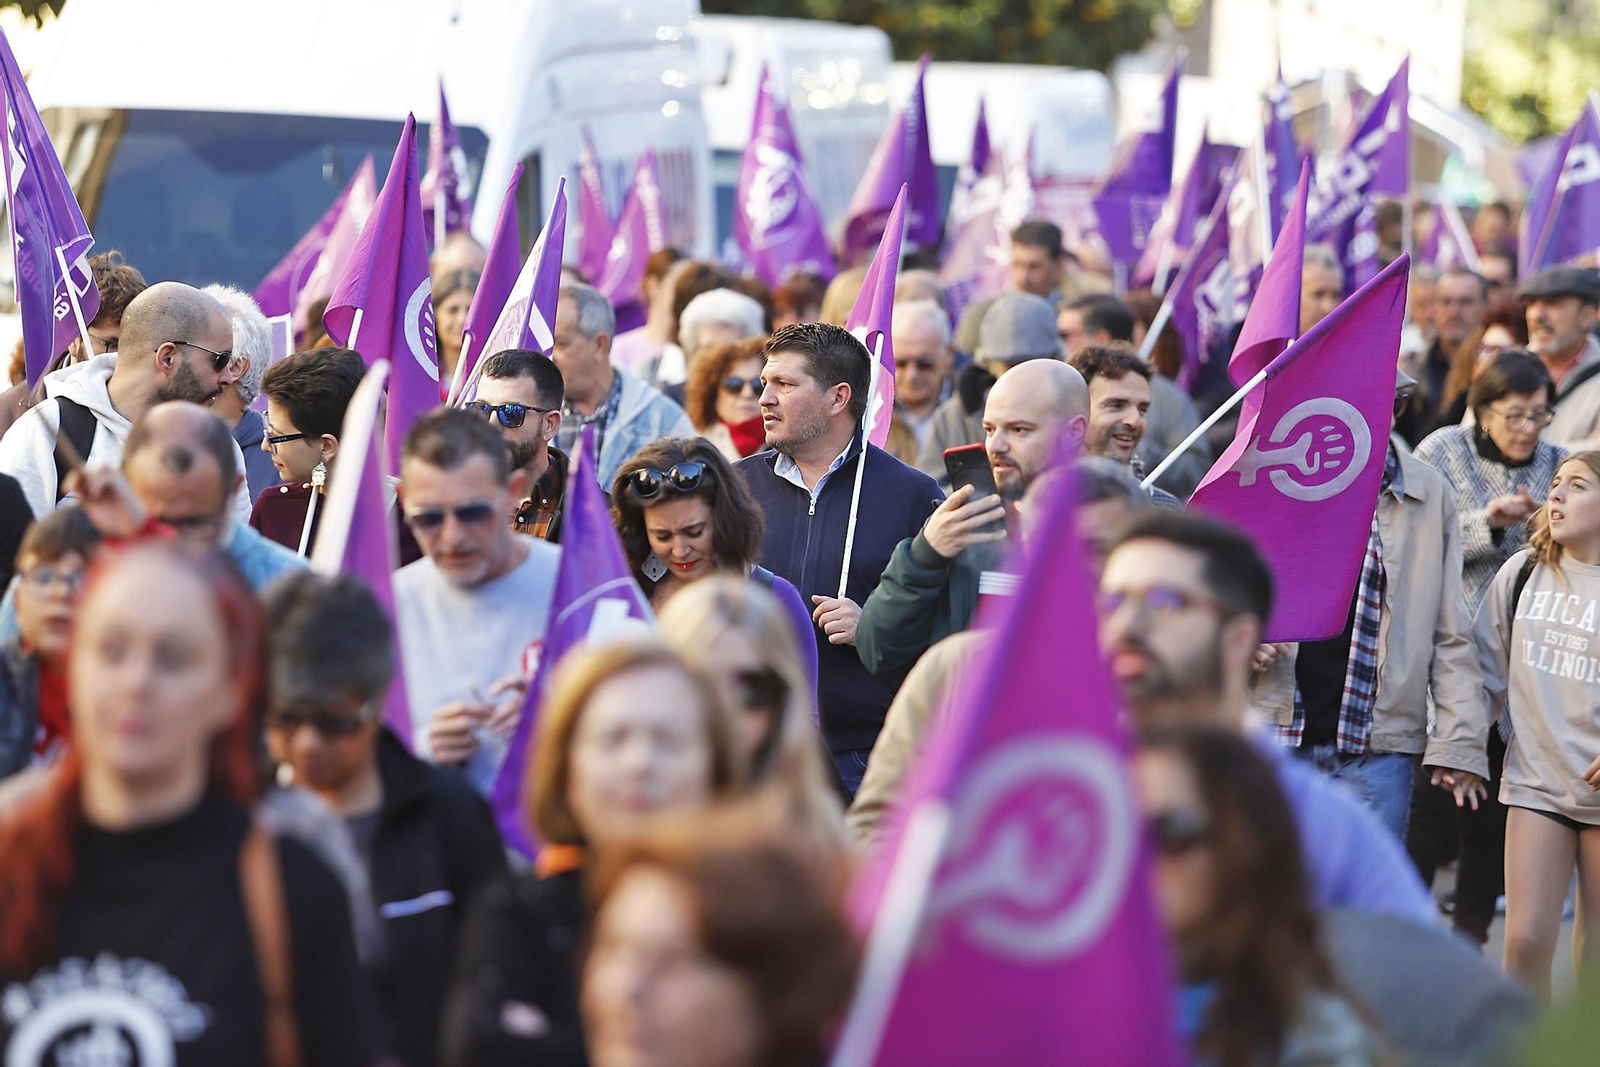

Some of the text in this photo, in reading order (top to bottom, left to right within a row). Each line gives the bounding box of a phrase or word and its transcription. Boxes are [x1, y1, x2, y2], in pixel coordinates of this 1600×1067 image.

[1515, 588, 1600, 633] CHICA
[1543, 629, 1567, 647] EST
[1521, 639, 1600, 683] ILLINOI
